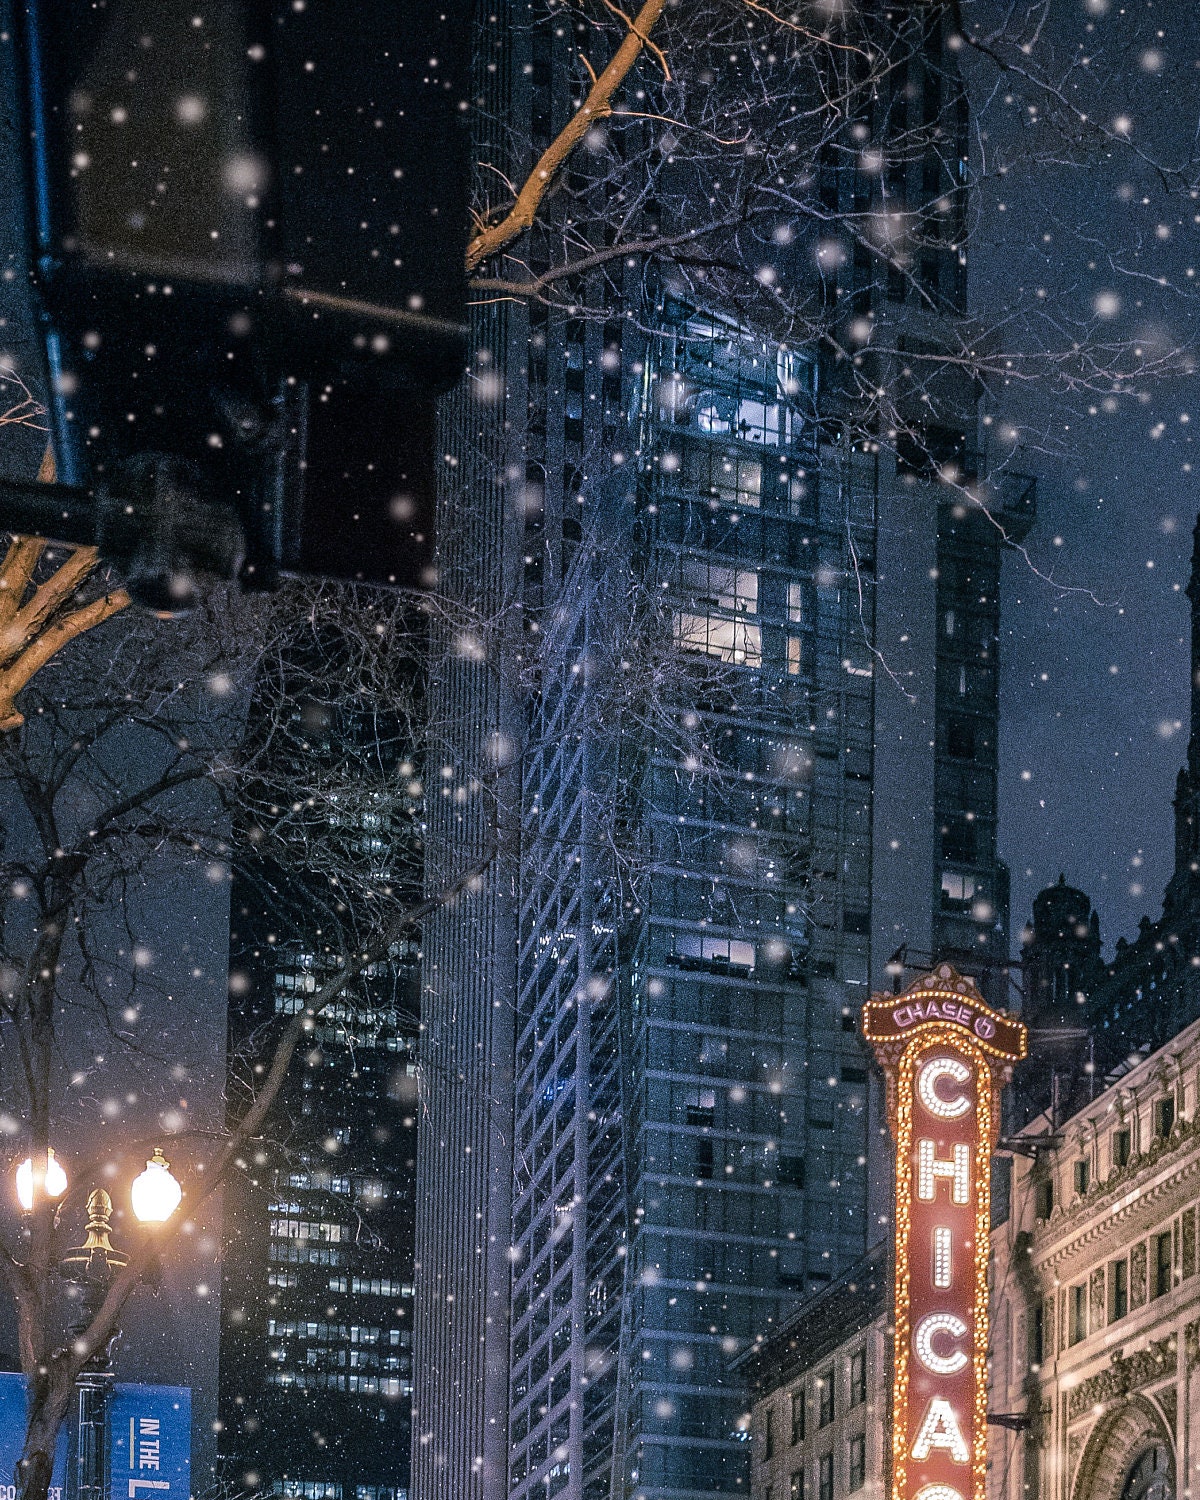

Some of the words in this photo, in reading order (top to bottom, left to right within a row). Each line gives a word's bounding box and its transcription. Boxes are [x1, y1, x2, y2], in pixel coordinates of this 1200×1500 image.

[892, 1000, 974, 1027] CHASE
[139, 1418, 160, 1436] IN
[139, 1440, 160, 1471] THE
